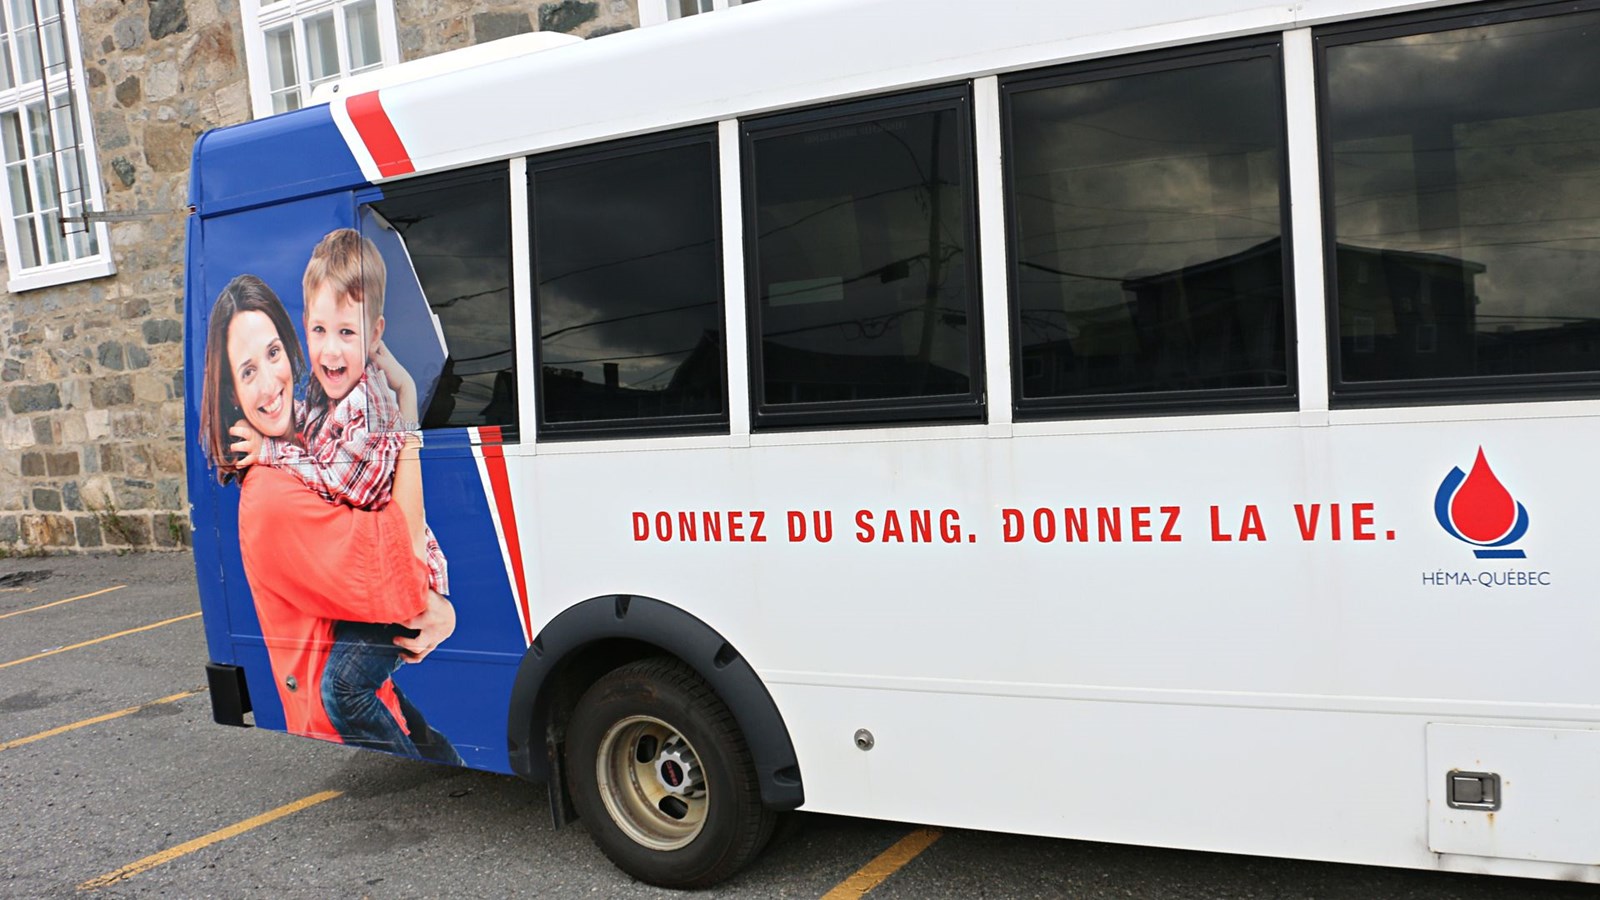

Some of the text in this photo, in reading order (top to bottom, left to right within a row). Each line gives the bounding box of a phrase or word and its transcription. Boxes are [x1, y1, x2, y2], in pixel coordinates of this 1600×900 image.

[632, 502, 1396, 544] DONNEZ DU SANG. DONNEZ LA VIE.
[1422, 568, 1551, 588] HÉMA-QUÉBEC
